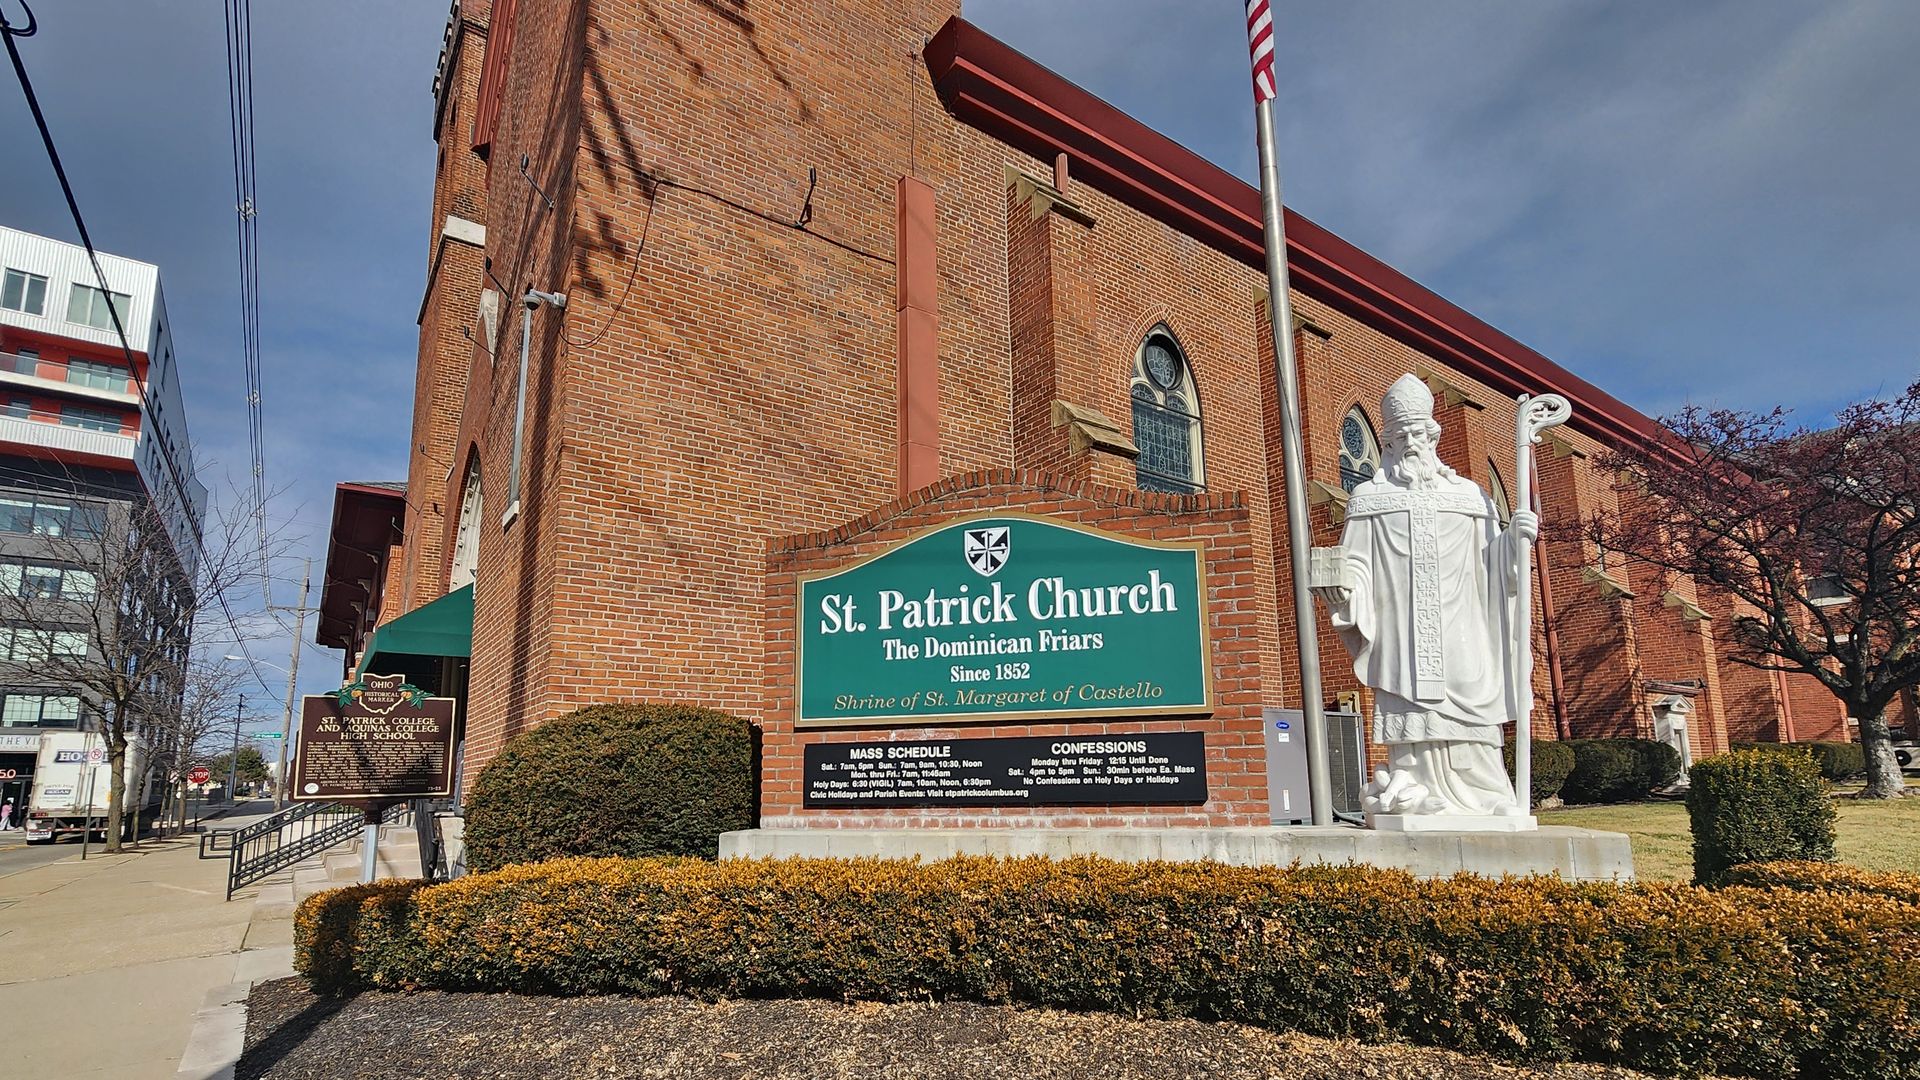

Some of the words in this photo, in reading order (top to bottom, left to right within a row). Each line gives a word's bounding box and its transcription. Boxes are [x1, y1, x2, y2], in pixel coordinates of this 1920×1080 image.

[820, 593, 866, 634] St.
[878, 581, 1018, 630] Patrick
[1029, 569, 1178, 620] Church
[883, 638, 919, 660] The
[924, 634, 1032, 658] Dominican
[1039, 629, 1104, 652] Friars
[950, 665, 990, 682] Since
[995, 663, 1030, 680] 1852
[834, 693, 896, 711] Shrine
[900, 691, 920, 711] of
[924, 690, 949, 707] St.
[955, 688, 1047, 712] Margaret
[1052, 684, 1073, 703] of
[1079, 682, 1163, 701] Castello
[850, 748, 882, 759] MASS
[888, 746, 950, 758] SCHEDULE
[1052, 741, 1146, 754] CONFESSIONS
[1032, 758, 1059, 766] Monday
[1079, 758, 1103, 766] Friday:
[869, 780, 894, 788] (VIGIL)
[1036, 776, 1080, 784] Confessions
[1095, 776, 1111, 785] Holy
[1114, 776, 1133, 784] Days
[1146, 776, 1179, 784] Holidays
[828, 791, 857, 799] Holidays
[945, 789, 1028, 798] stpatrickcolumbus.org
